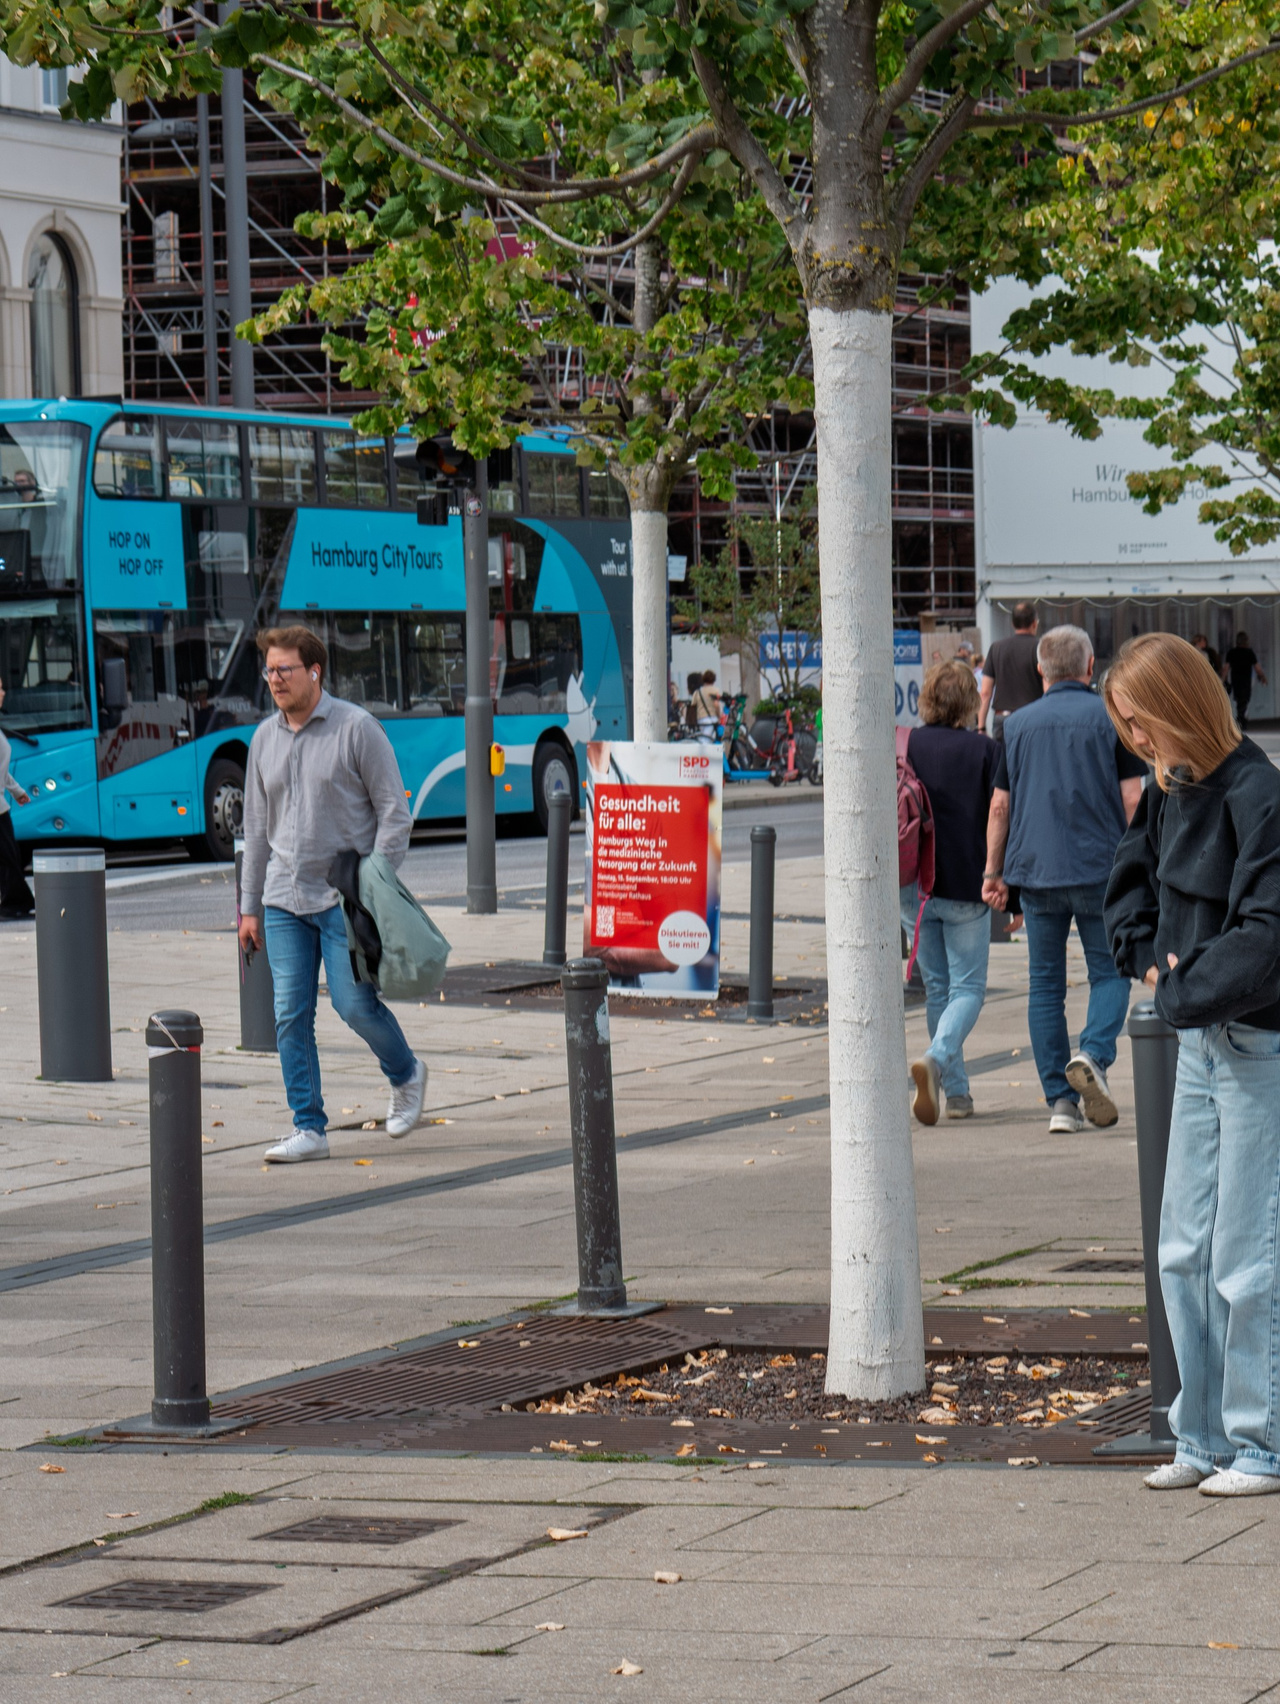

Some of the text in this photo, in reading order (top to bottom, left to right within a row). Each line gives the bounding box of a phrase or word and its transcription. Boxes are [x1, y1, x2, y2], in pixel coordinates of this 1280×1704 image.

[1096, 464, 1126, 482] Wir
[109, 530, 150, 549] HOP ON
[610, 538, 626, 554] Tour
[119, 557, 164, 576] HOP OFF
[311, 541, 378, 576] Hamburg
[600, 559, 617, 576] with
[765, 641, 807, 660] SAFETY
[683, 756, 710, 768] SPD
[599, 794, 680, 813] Gesundheit
[599, 812, 646, 830] für alle:
[598, 835, 668, 849] Hamburgs Weg in
[597, 846, 662, 859] die medizinische
[597, 859, 697, 872] Versorgung der Zukunft
[660, 929, 708, 938] Diskutieren
[668, 941, 681, 949] Sie
